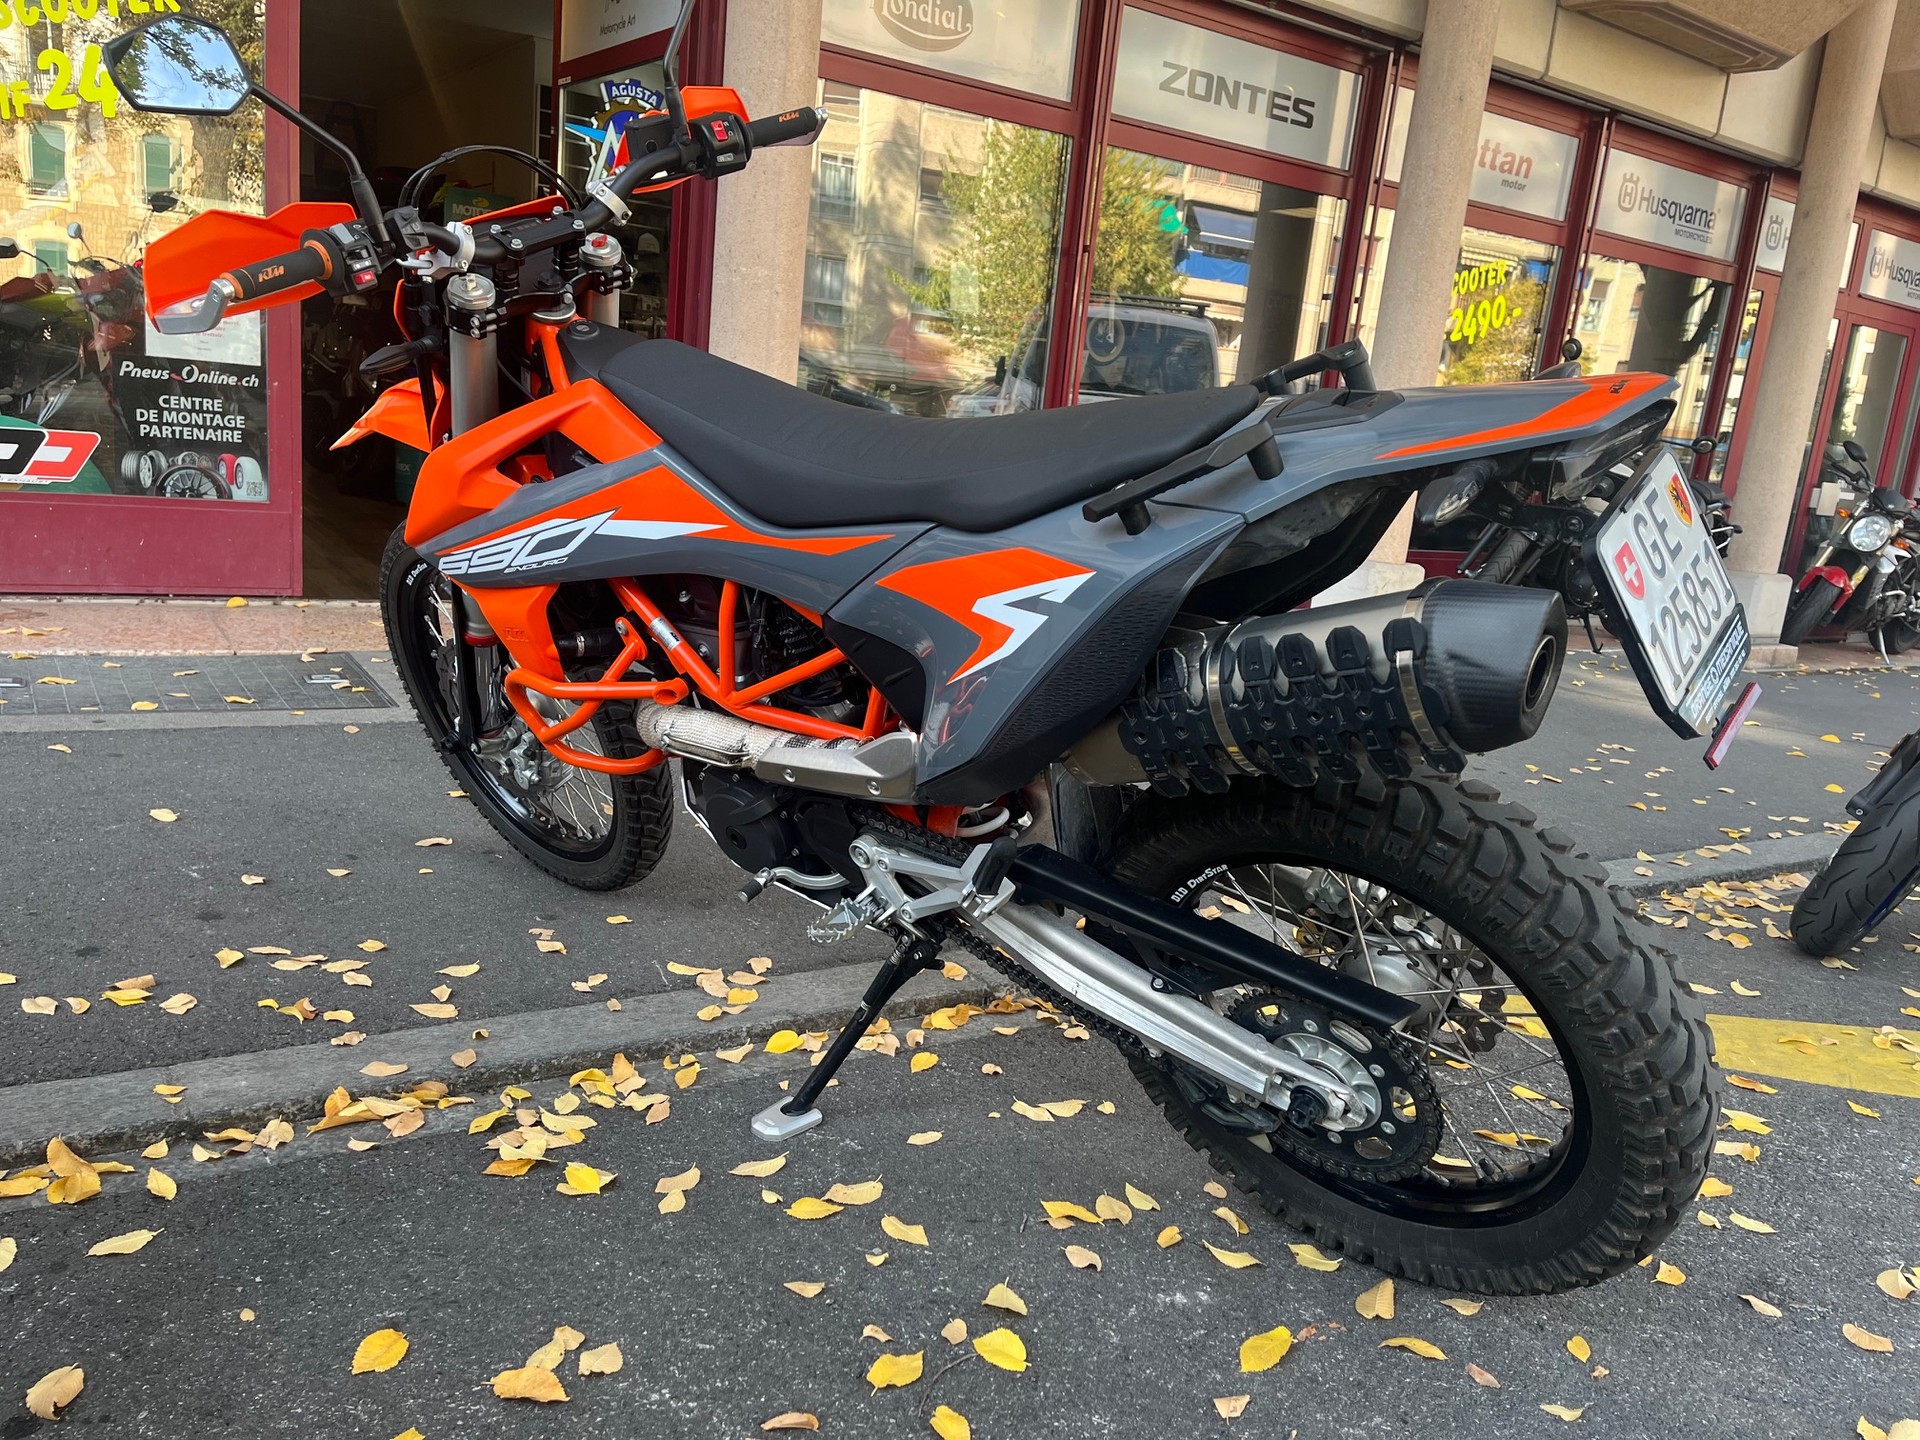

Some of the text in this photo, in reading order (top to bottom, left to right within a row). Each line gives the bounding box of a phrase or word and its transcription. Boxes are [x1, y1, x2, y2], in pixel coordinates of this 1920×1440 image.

[611, 85, 658, 107] AGUSTA
[1159, 60, 1316, 129] ZONTES
[779, 112, 800, 122] KTM
[1501, 179, 1527, 192] motor
[1638, 187, 1717, 230] Husqvarna
[1674, 228, 1713, 245] MOTORCYCLES
[259, 265, 284, 282] KTM
[158, 395, 223, 412] CENTRE
[136, 409, 246, 428] DE MONTAGE
[140, 424, 243, 443] PARTENAIRE
[438, 509, 616, 575] 690
[1631, 487, 1682, 580] GE
[503, 556, 569, 574] ENDURO
[1650, 539, 1732, 691] 125851
